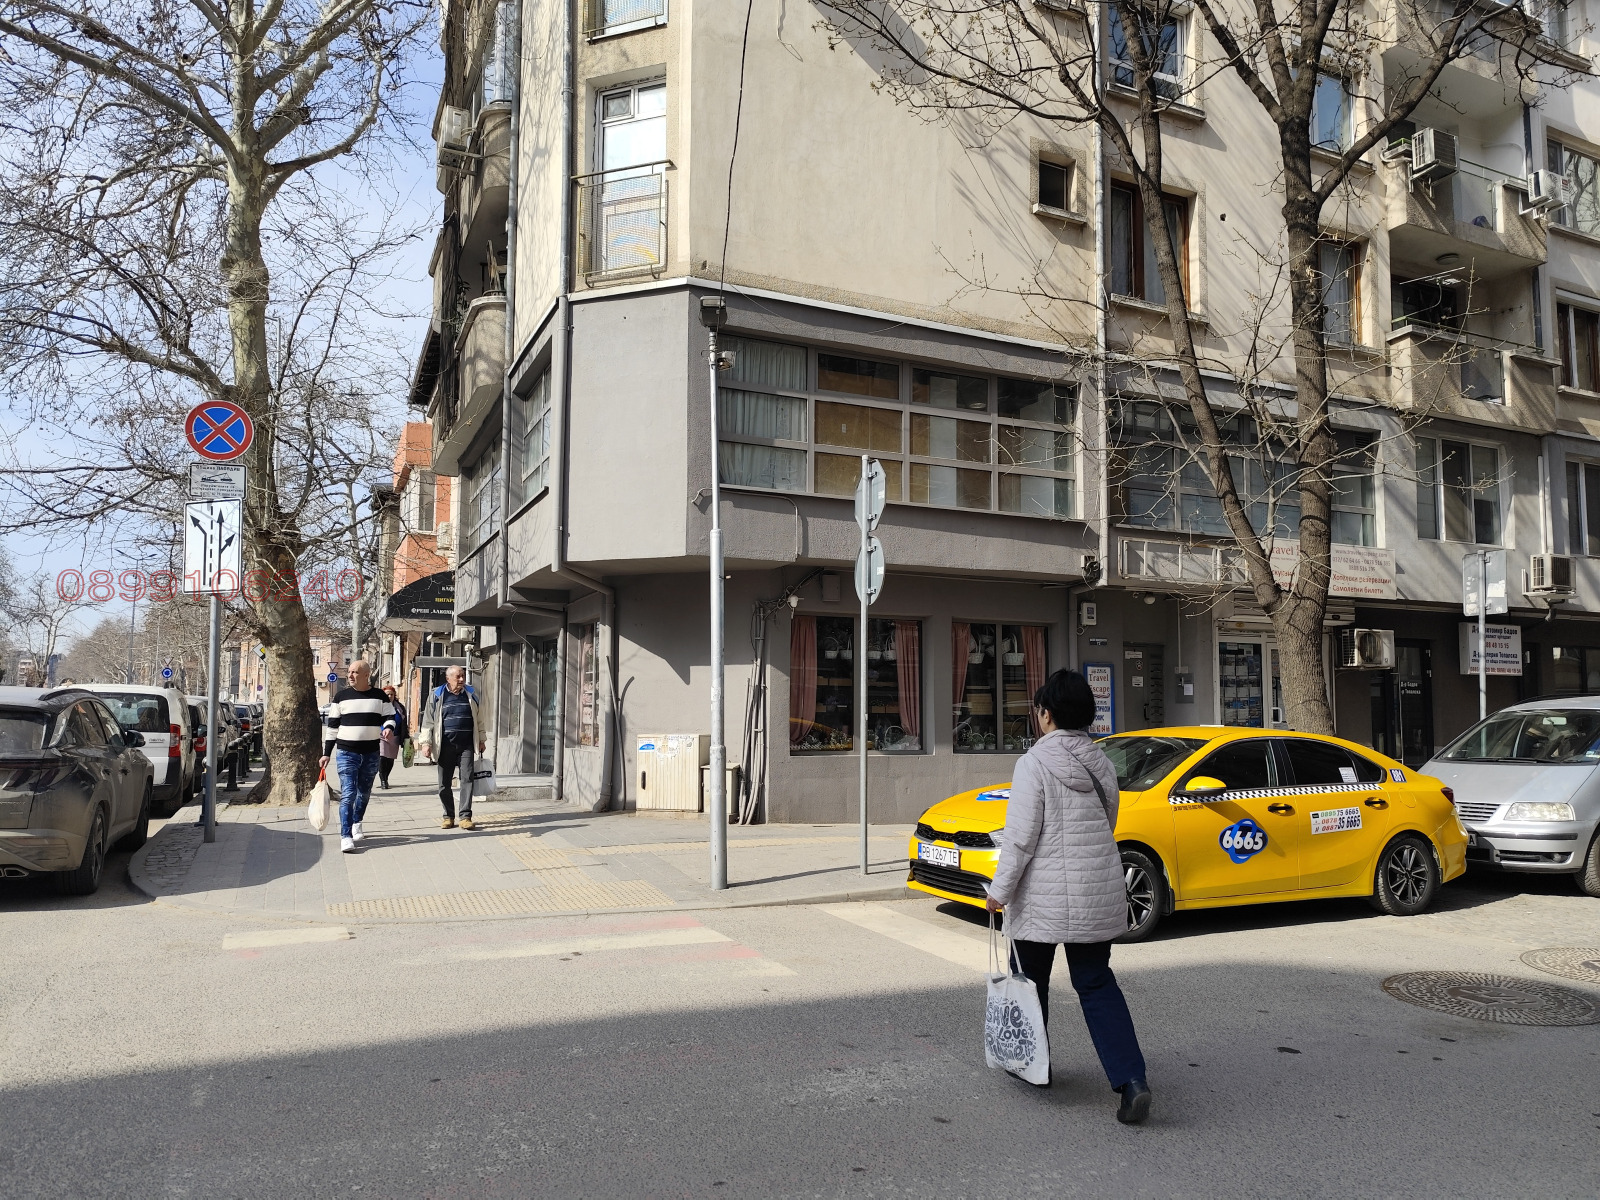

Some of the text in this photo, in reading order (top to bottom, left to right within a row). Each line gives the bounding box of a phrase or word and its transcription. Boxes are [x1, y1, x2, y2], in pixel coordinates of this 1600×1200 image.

[1271, 546, 1294, 556] ravel
[1333, 585, 1384, 594] Самолетни билети
[1088, 674, 1109, 682] Travel
[1337, 809, 1344, 817] 75
[1345, 807, 1359, 816] 6665
[1321, 815, 1361, 830] 0878 35 6665
[1321, 824, 1338, 832] 0887
[1222, 829, 1264, 850] 6665
[932, 848, 948, 862] 1267
[948, 850, 958, 864] TE
